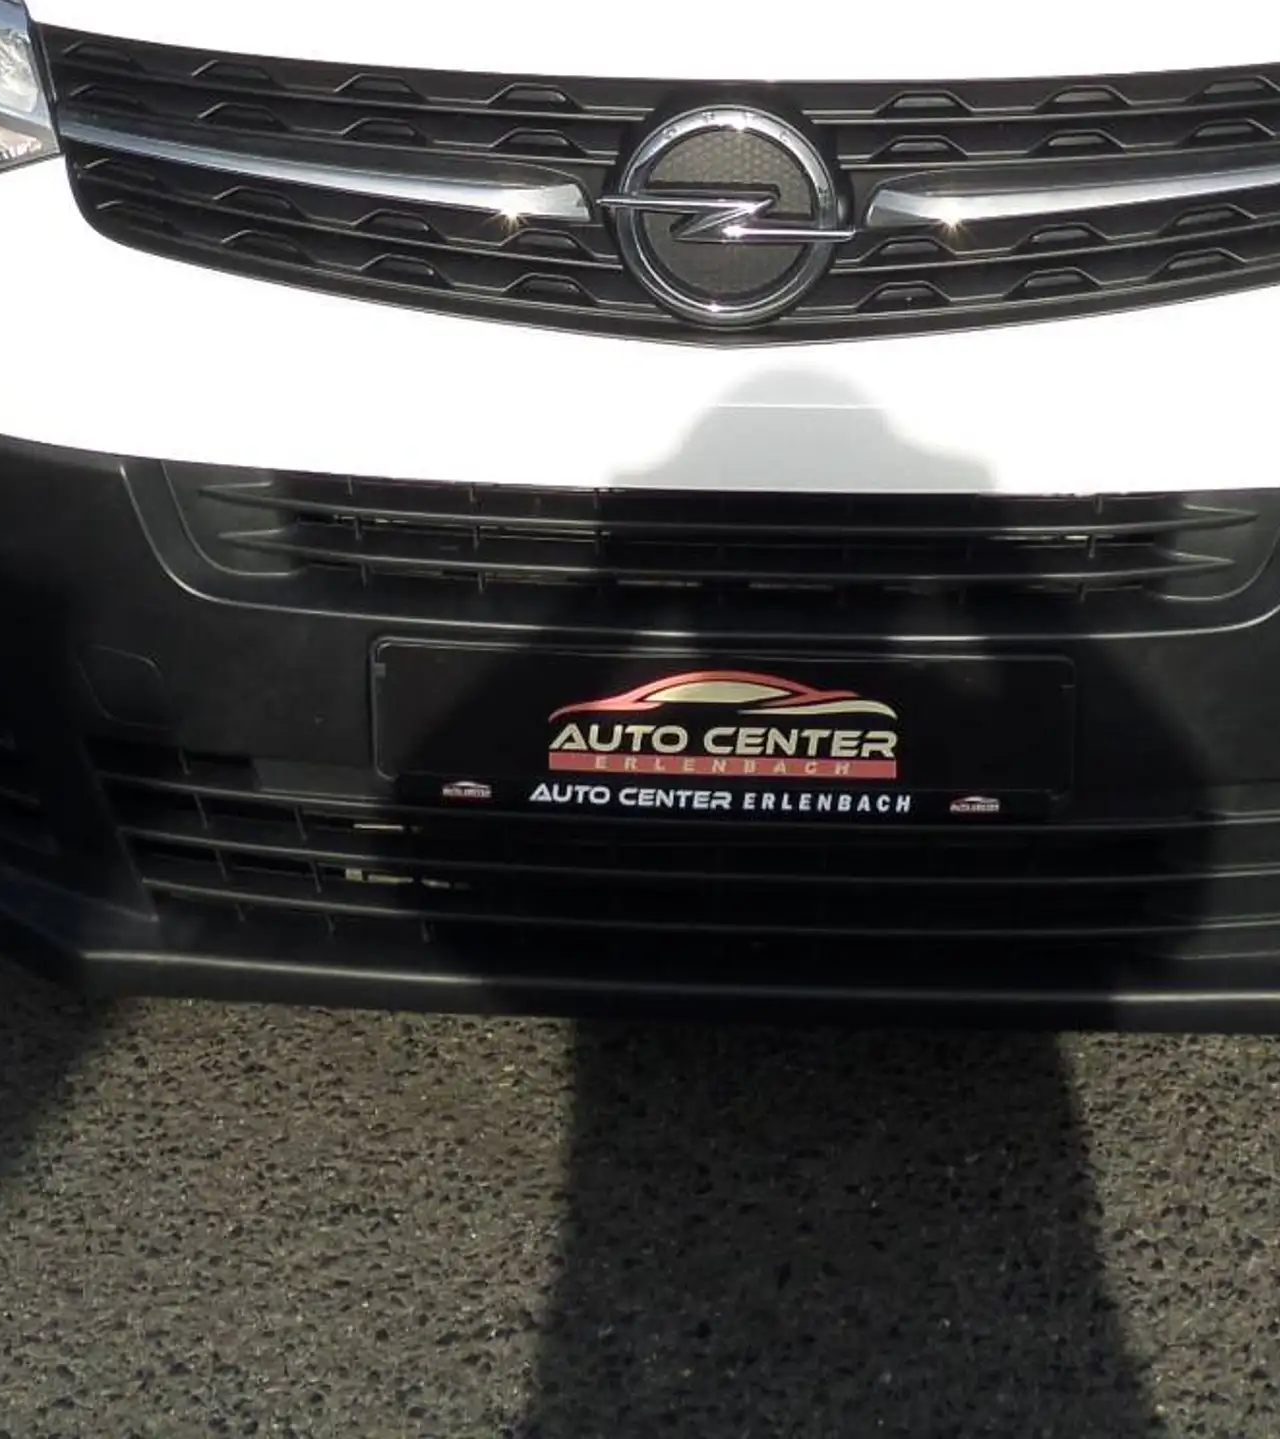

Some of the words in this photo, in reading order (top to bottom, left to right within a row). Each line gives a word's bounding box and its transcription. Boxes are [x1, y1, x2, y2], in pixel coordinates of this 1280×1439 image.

[548, 723, 689, 754] AUTO
[703, 726, 898, 758] CENTER
[594, 755, 851, 776] ERLENBACH
[529, 782, 611, 805] AUTO
[619, 787, 733, 810] CENTER
[742, 791, 911, 813] ERLENBACH
